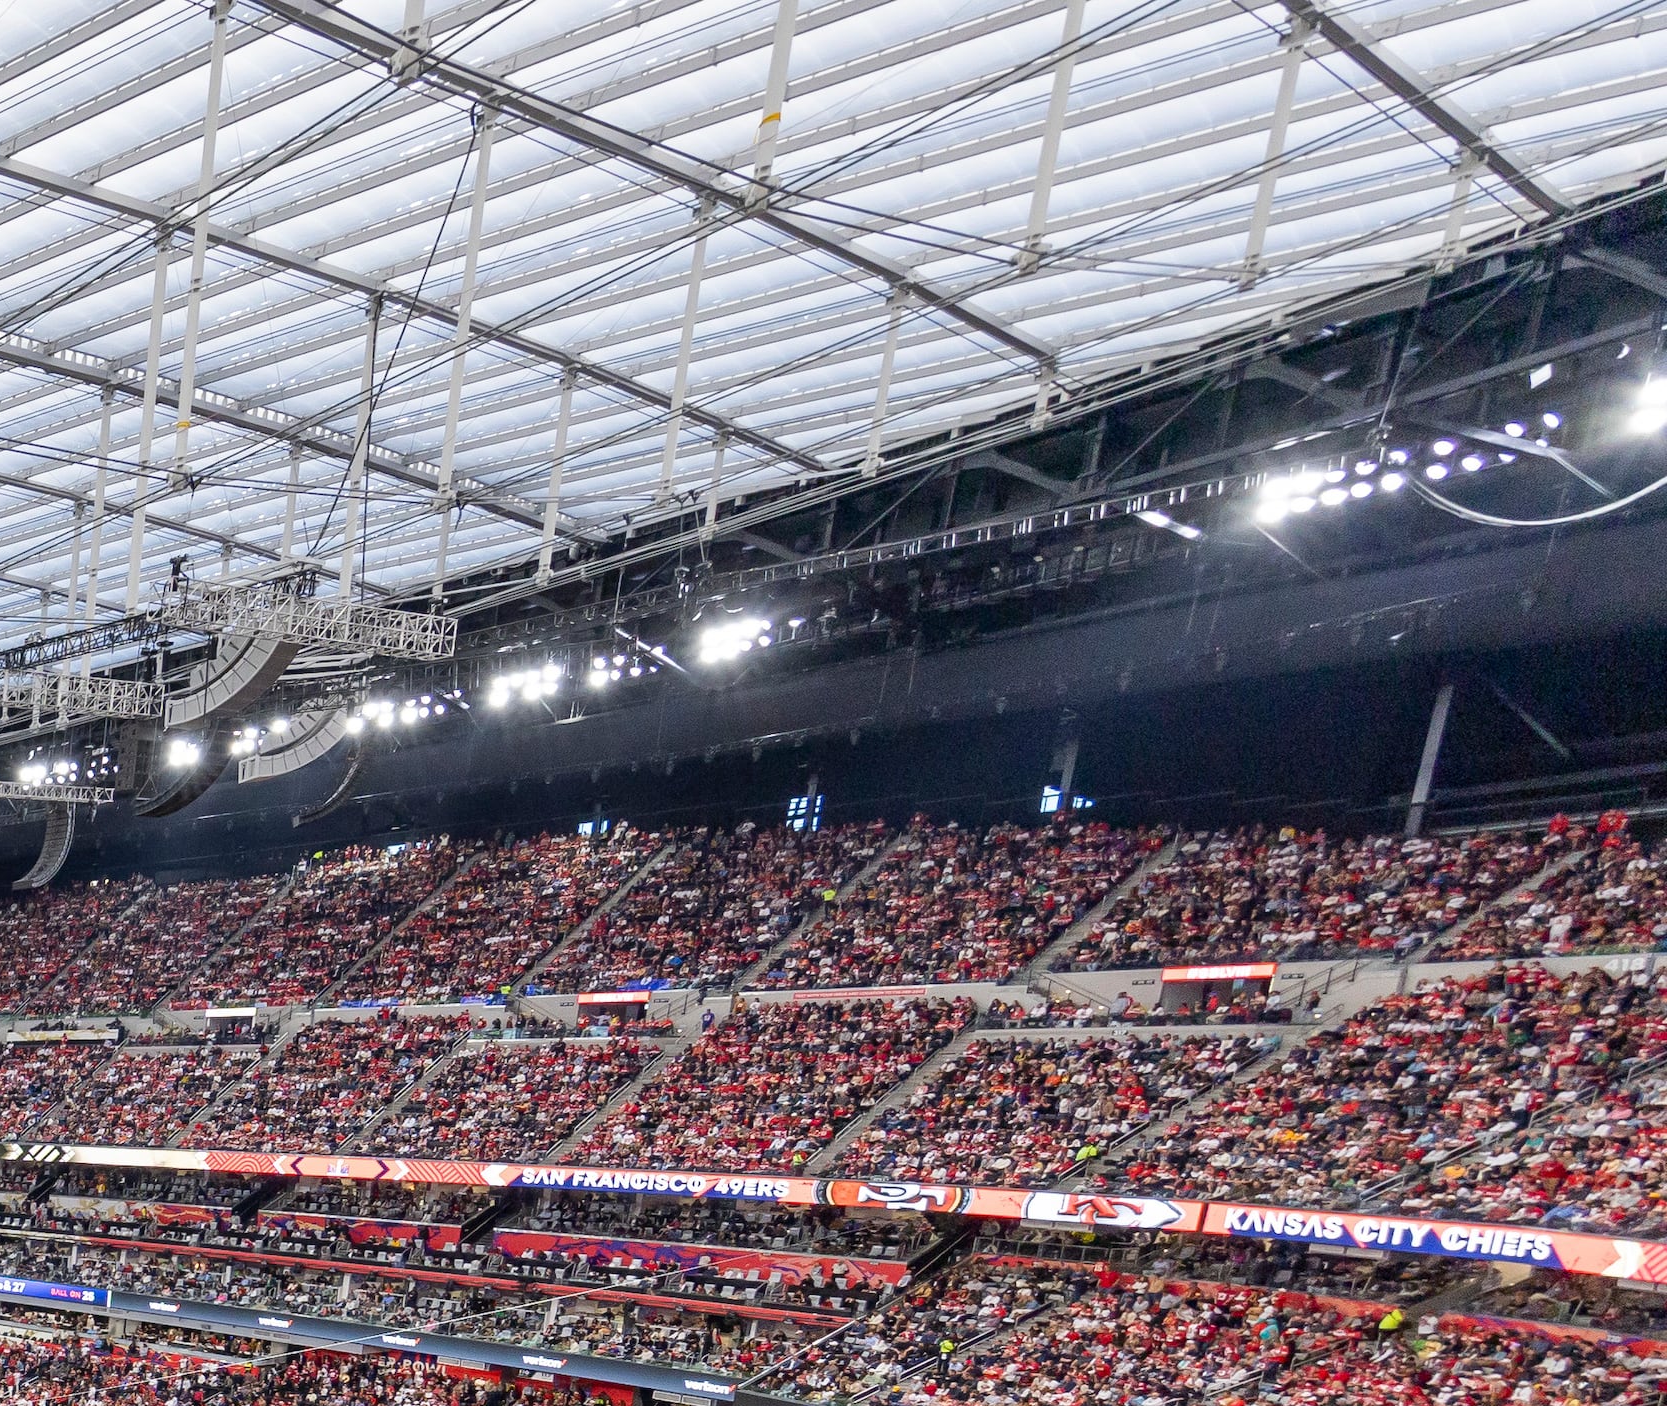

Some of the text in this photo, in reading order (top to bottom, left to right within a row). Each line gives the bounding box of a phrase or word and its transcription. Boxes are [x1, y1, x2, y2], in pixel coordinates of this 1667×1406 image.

[521, 1167, 790, 1199] SAN FRANCISCO 49ERS
[1223, 1207, 1554, 1261] KANSAS CITY CHIEFS
[12, 1281, 26, 1292] 27
[50, 1288, 68, 1297] BALL
[69, 1290, 81, 1299] ON
[523, 1355, 562, 1369] verizon
[684, 1378, 729, 1395] verizon
